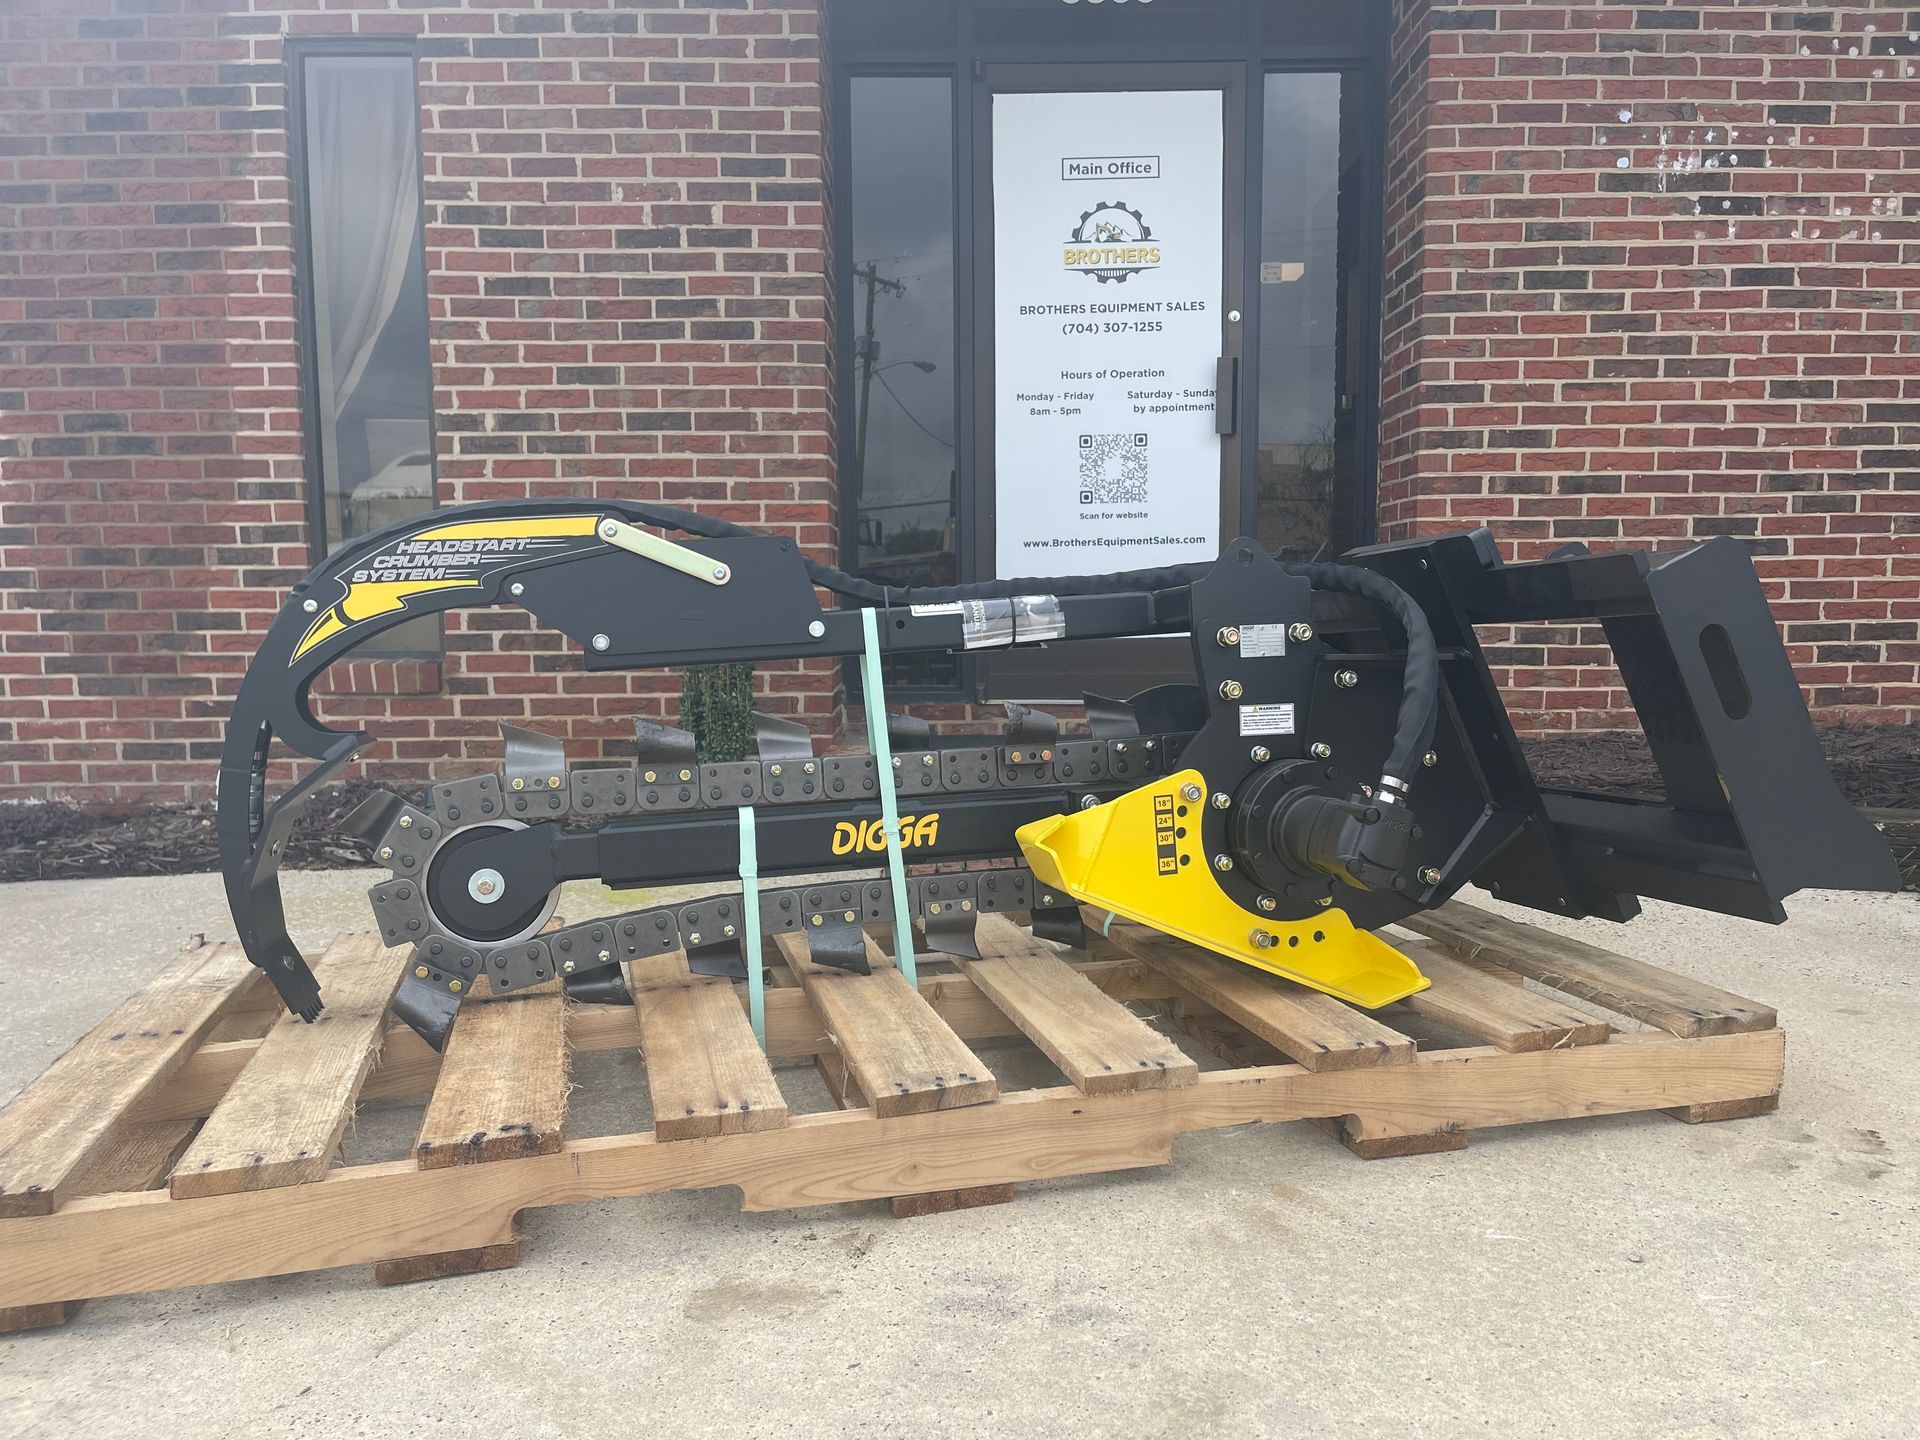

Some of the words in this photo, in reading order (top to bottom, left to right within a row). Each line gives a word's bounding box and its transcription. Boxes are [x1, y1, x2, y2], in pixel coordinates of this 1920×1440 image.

[1069, 163, 1103, 175] Main
[1107, 162, 1152, 175] Office
[1063, 247, 1161, 266] BROTHERS
[1019, 304, 1087, 316] BROTHERS
[1089, 302, 1163, 314] EQUIPMENT
[1165, 301, 1206, 313] SALES
[1062, 323, 1100, 336] (704)
[1103, 321, 1163, 333] 307-1255
[1060, 370, 1093, 380] Hours
[1095, 369, 1108, 379] of
[1109, 368, 1165, 380] Operation
[1016, 392, 1055, 403] Monday
[1063, 391, 1095, 402] Friday
[1127, 389, 1173, 400] Saturday
[1029, 407, 1051, 416] 8am
[1059, 407, 1082, 417] 5pm
[1133, 404, 1146, 414] by
[1149, 402, 1215, 414] appointment
[1079, 512, 1099, 520] Scan
[1101, 511, 1114, 520] for
[1115, 511, 1149, 519] website
[396, 538, 531, 553] HEADSTART
[1022, 536, 1206, 548] www.BrothersEquipmentSales.com
[373, 553, 482, 568] CRUMBER
[352, 568, 446, 583] SYSTEM
[832, 813, 940, 855] DIGGA
